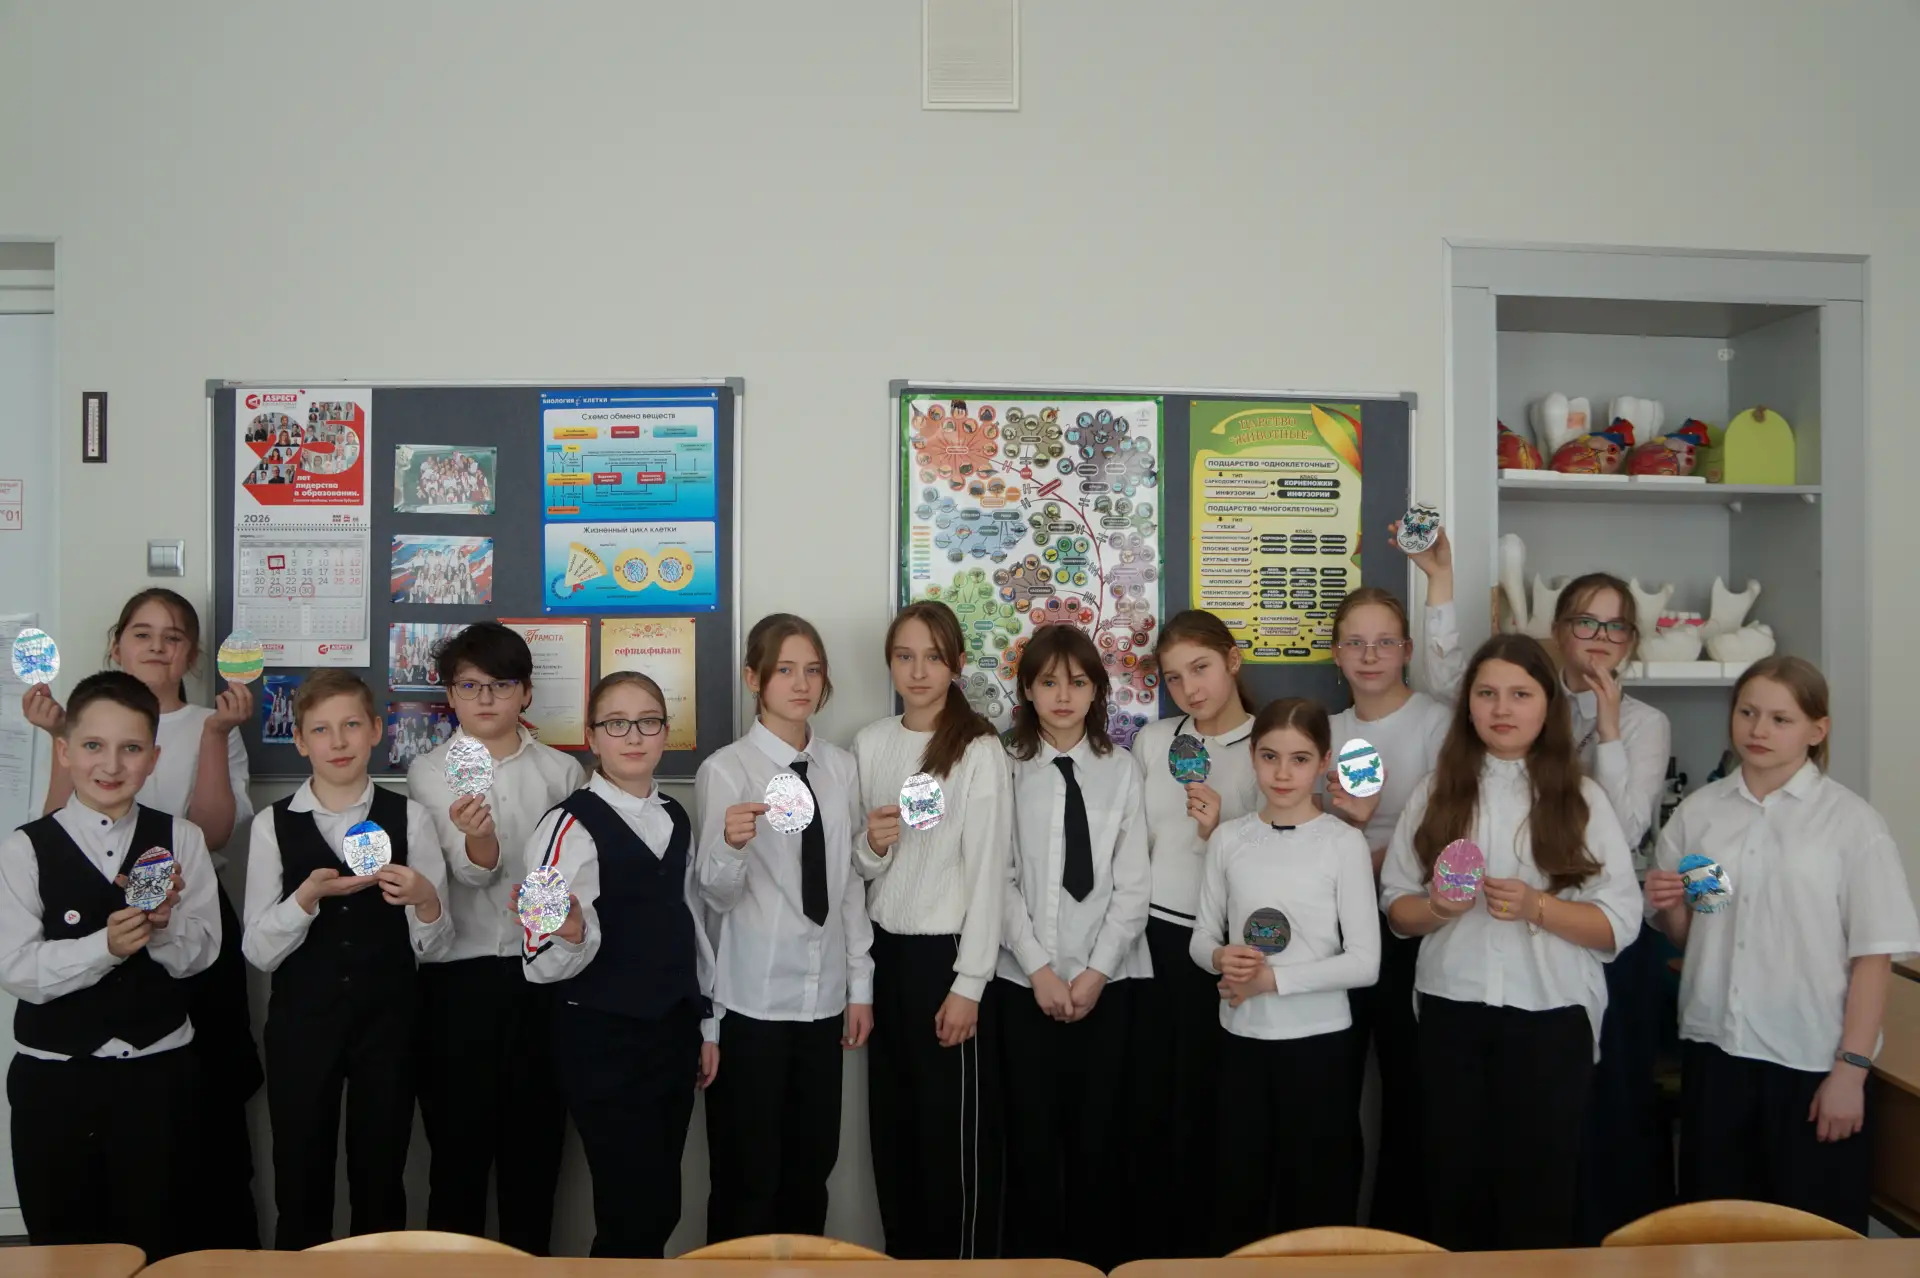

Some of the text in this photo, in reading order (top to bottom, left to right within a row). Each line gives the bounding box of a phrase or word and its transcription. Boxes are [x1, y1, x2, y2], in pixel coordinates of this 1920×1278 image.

[1239, 416, 1298, 430] ЦАРСТВО
[244, 514, 271, 522] 2026
[614, 646, 682, 656] сертификат
